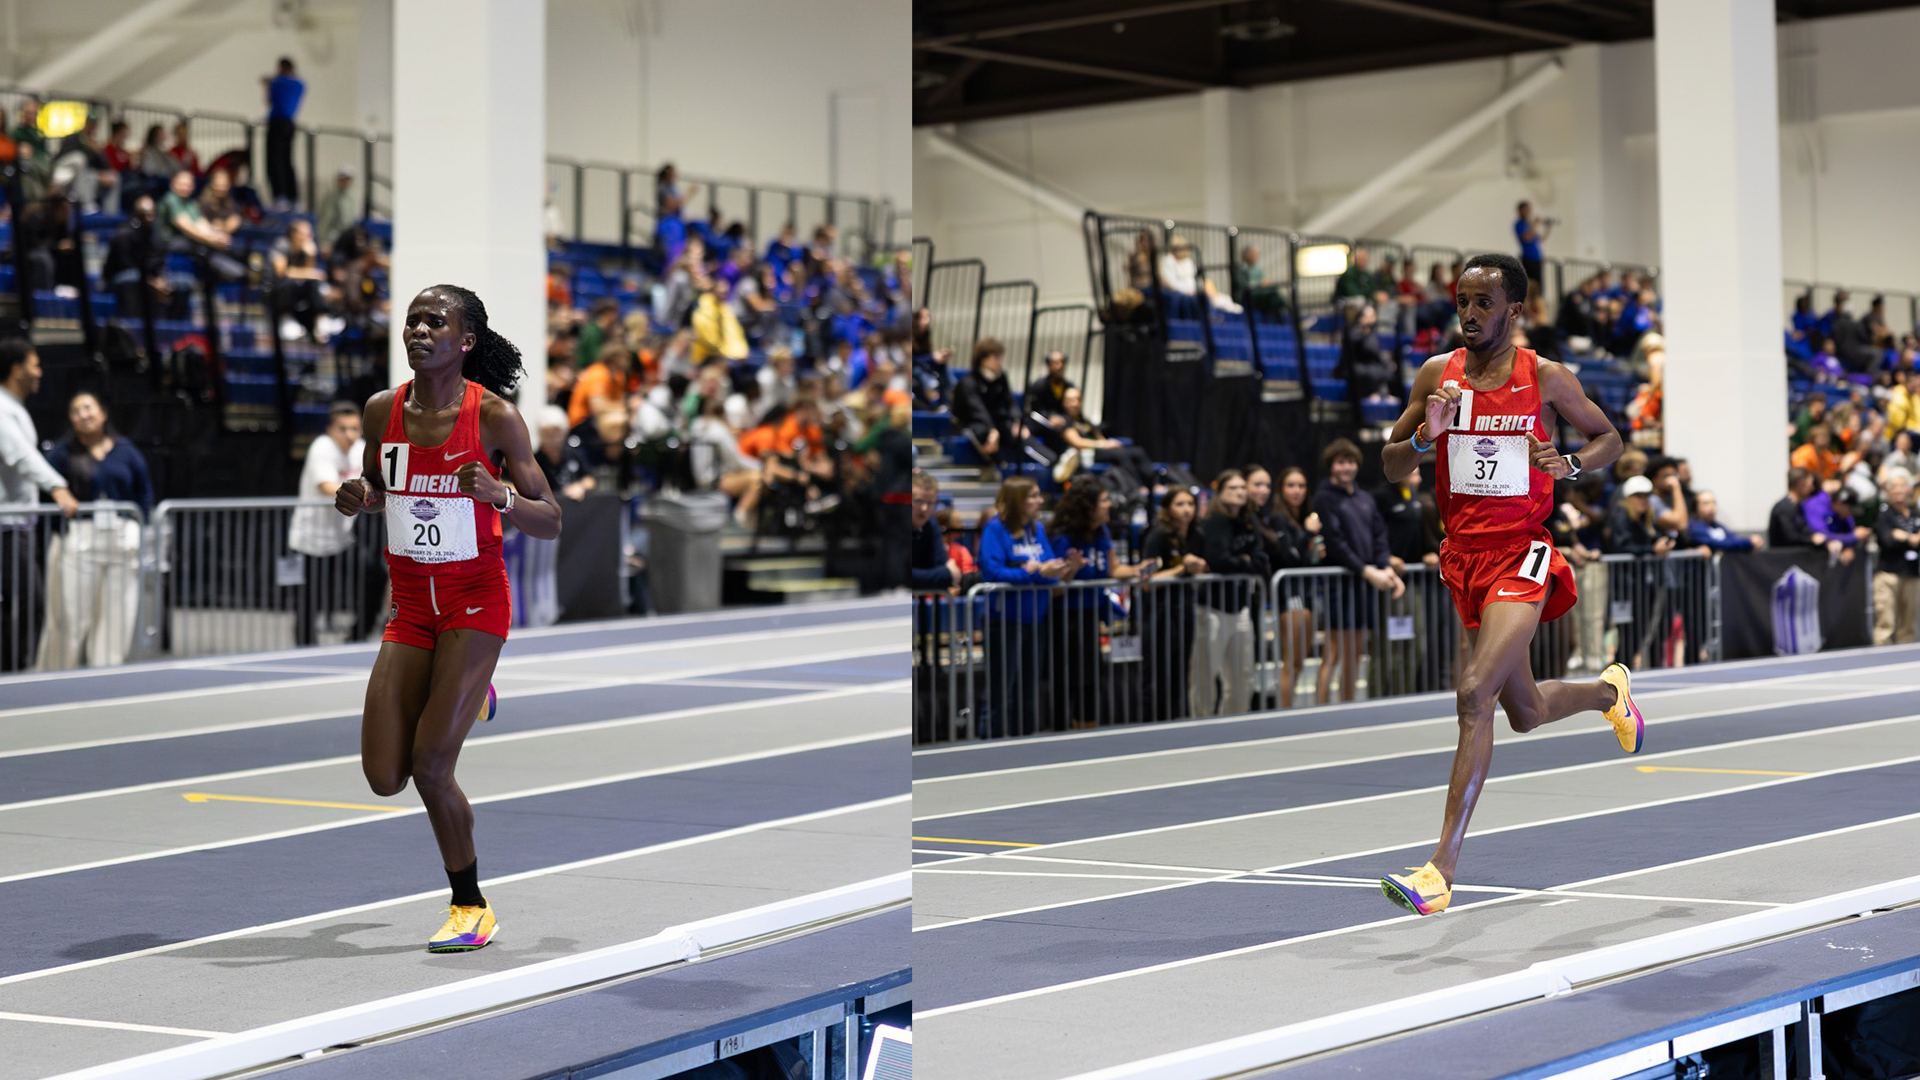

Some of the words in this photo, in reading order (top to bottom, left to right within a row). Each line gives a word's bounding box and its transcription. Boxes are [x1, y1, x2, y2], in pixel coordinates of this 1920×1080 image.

[1474, 415, 1536, 431] MEXICO
[385, 446, 399, 487] 1
[1474, 459, 1498, 480] 37
[409, 474, 459, 494] MEXI
[413, 523, 441, 547] 20
[1530, 545, 1548, 578] 1
